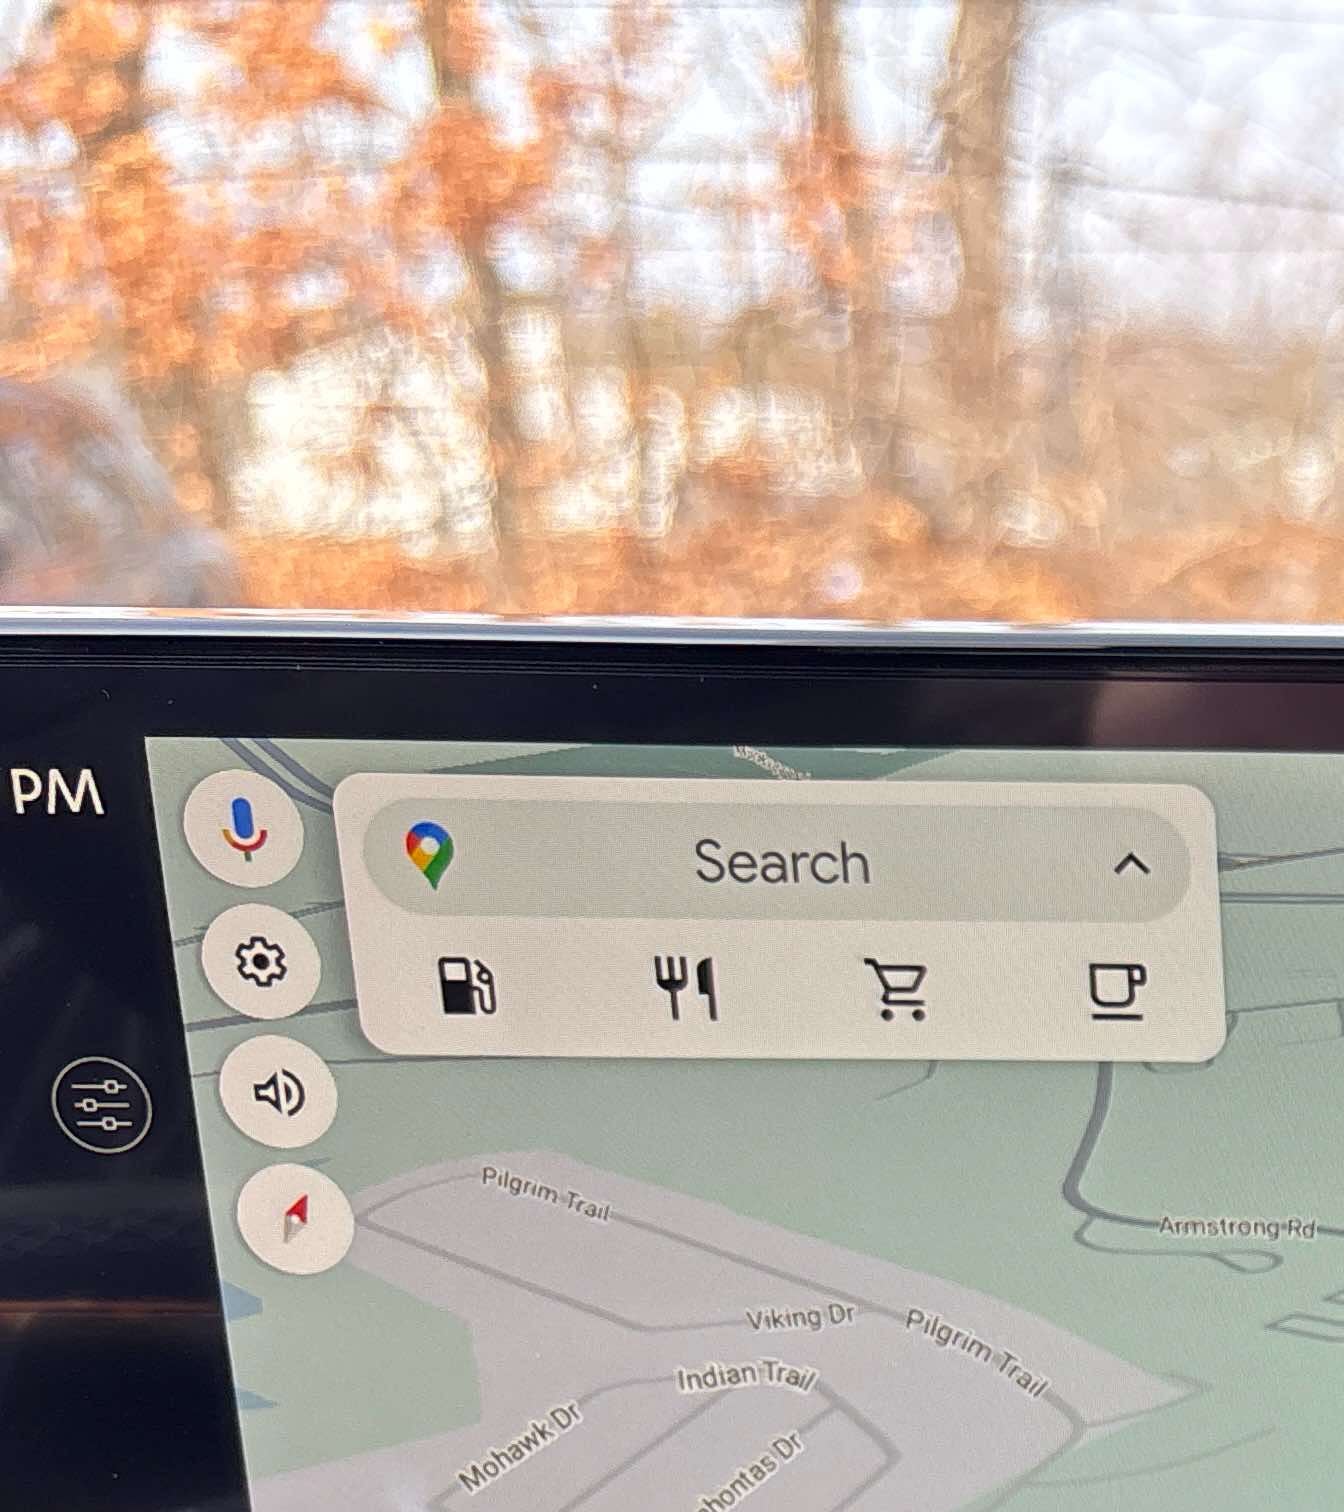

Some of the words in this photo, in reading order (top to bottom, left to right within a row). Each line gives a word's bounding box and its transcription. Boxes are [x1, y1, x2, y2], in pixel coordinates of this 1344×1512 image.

[10, 767, 105, 815] PM
[695, 837, 871, 885] Search
[481, 1164, 562, 1205] Pilgrim
[565, 1196, 612, 1222] Trail
[1160, 1214, 1281, 1238] Armstrong
[1287, 1217, 1317, 1239] Rd
[746, 1305, 825, 1334] Viking
[827, 1302, 857, 1327] Dr
[675, 1361, 758, 1395] Indian
[762, 1358, 817, 1392] Trail
[905, 1307, 996, 1366] Pilgrim
[997, 1352, 1048, 1399] Trail
[458, 1422, 555, 1493] Mohawk
[549, 1402, 582, 1431] Dr
[770, 1428, 805, 1462] Dr
